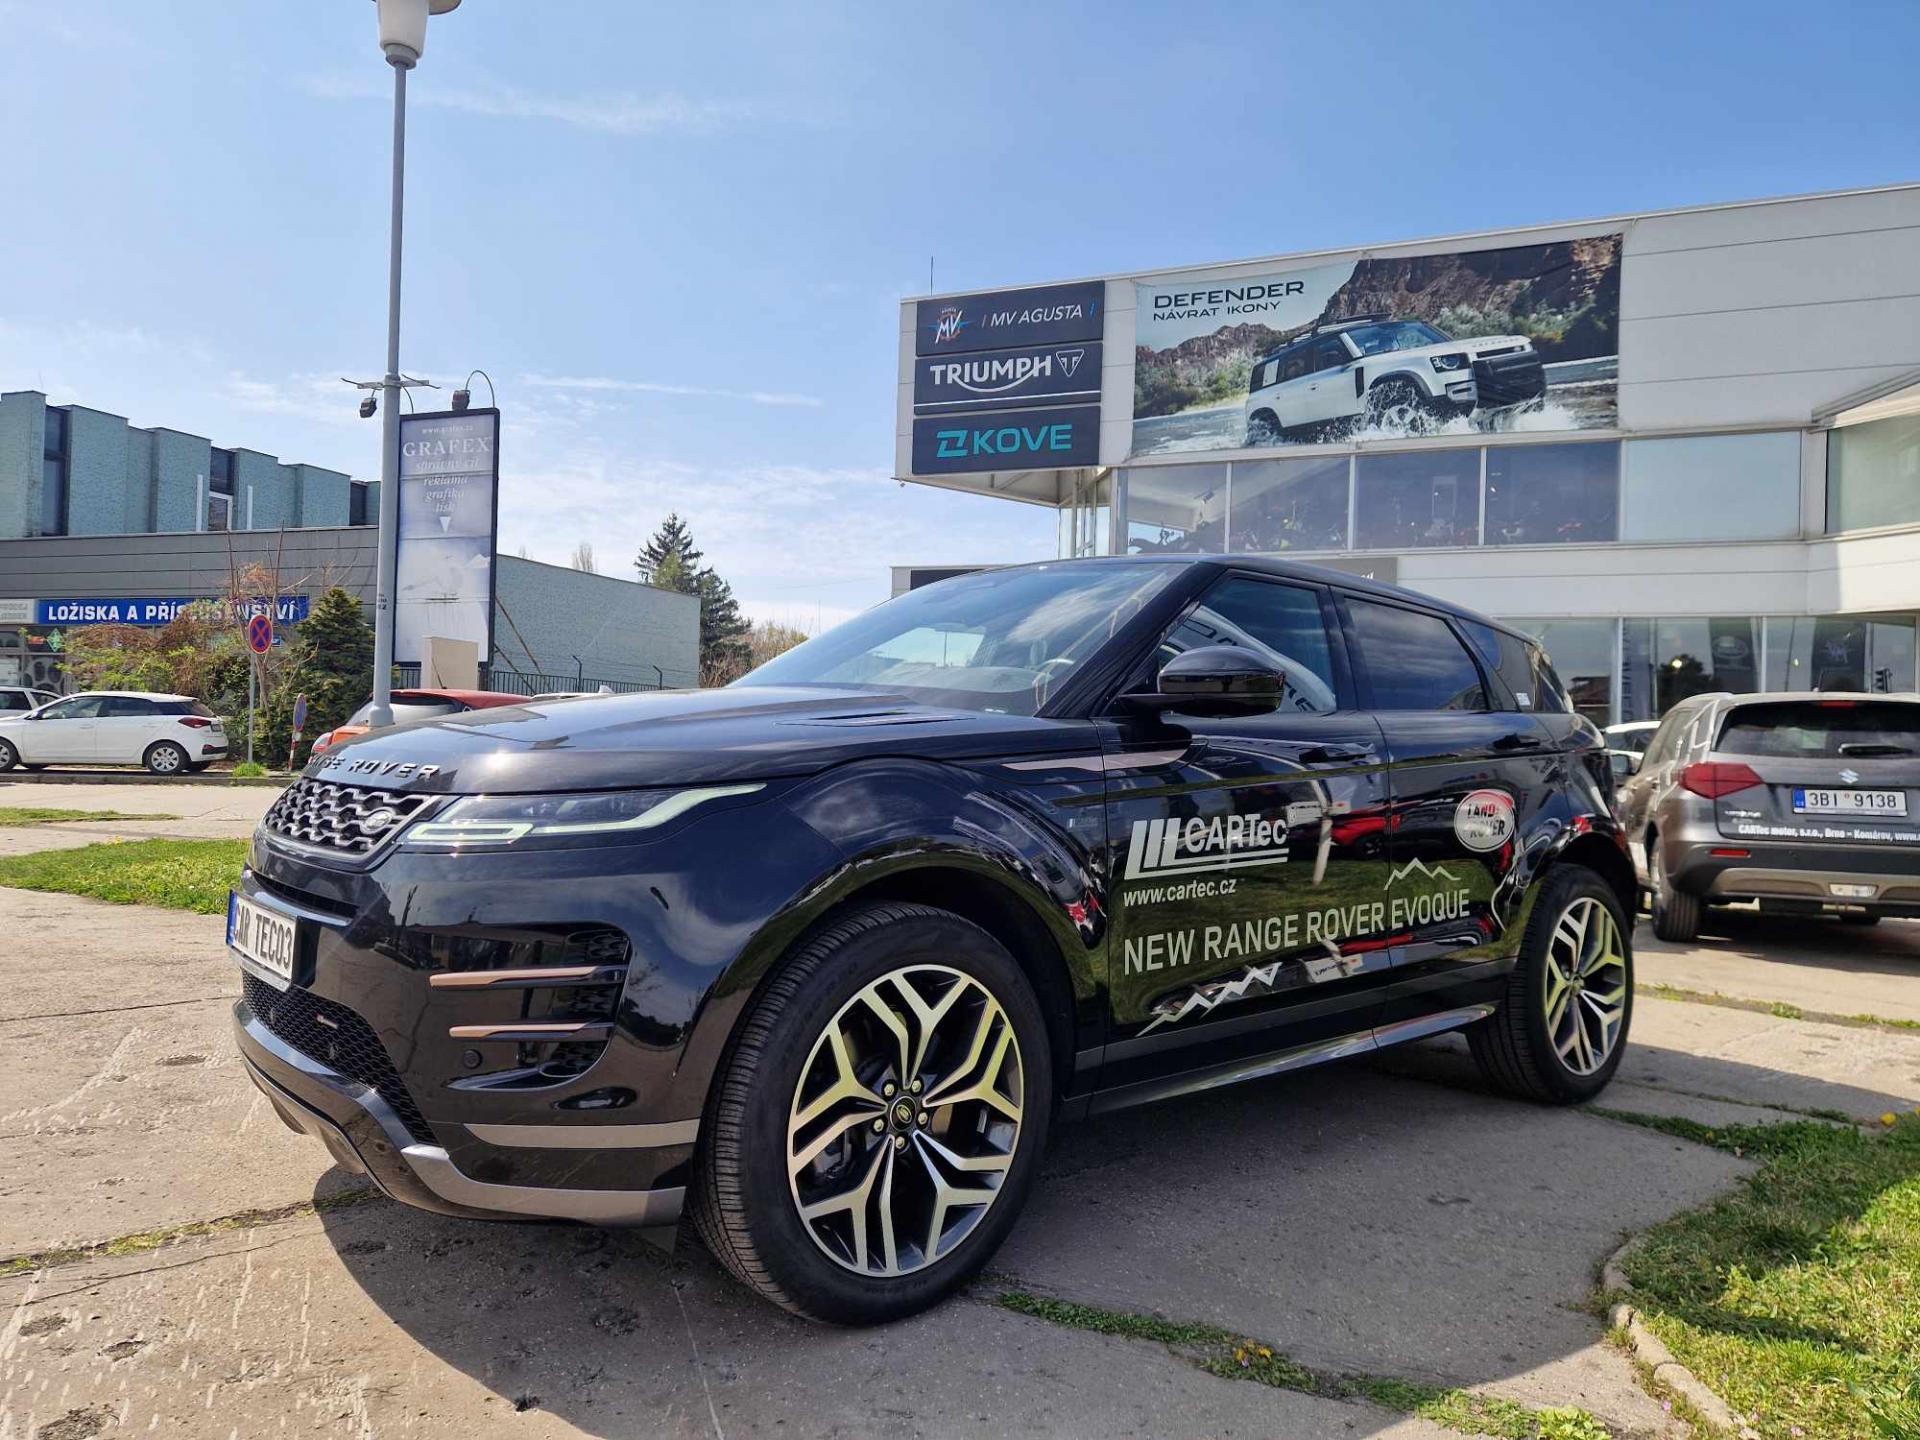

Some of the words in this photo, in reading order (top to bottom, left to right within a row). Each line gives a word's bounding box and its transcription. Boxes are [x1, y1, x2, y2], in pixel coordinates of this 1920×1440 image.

[1154, 280, 1305, 309] DEFENDER
[990, 311, 1017, 327] MV
[1018, 304, 1083, 324] AGUSTA
[1153, 306, 1220, 321] NÁVRAT
[1227, 301, 1281, 316] IKONY
[935, 310, 963, 345] MV
[930, 355, 1052, 392] TRIUMPH
[402, 437, 490, 457] GRAFEX
[973, 423, 1073, 455] KOVE
[48, 602, 120, 621] LOŽISKA
[126, 605, 138, 620] A
[348, 759, 441, 779] ROVER
[1854, 793, 1897, 808] 9138
[1184, 813, 1288, 853] CARTec
[1123, 879, 1237, 907] www.cartec.cz
[1124, 930, 1196, 976] NEW
[1204, 914, 1299, 962] RANGE
[1307, 902, 1385, 944] ROVER
[1390, 889, 1471, 931] EVOQUE
